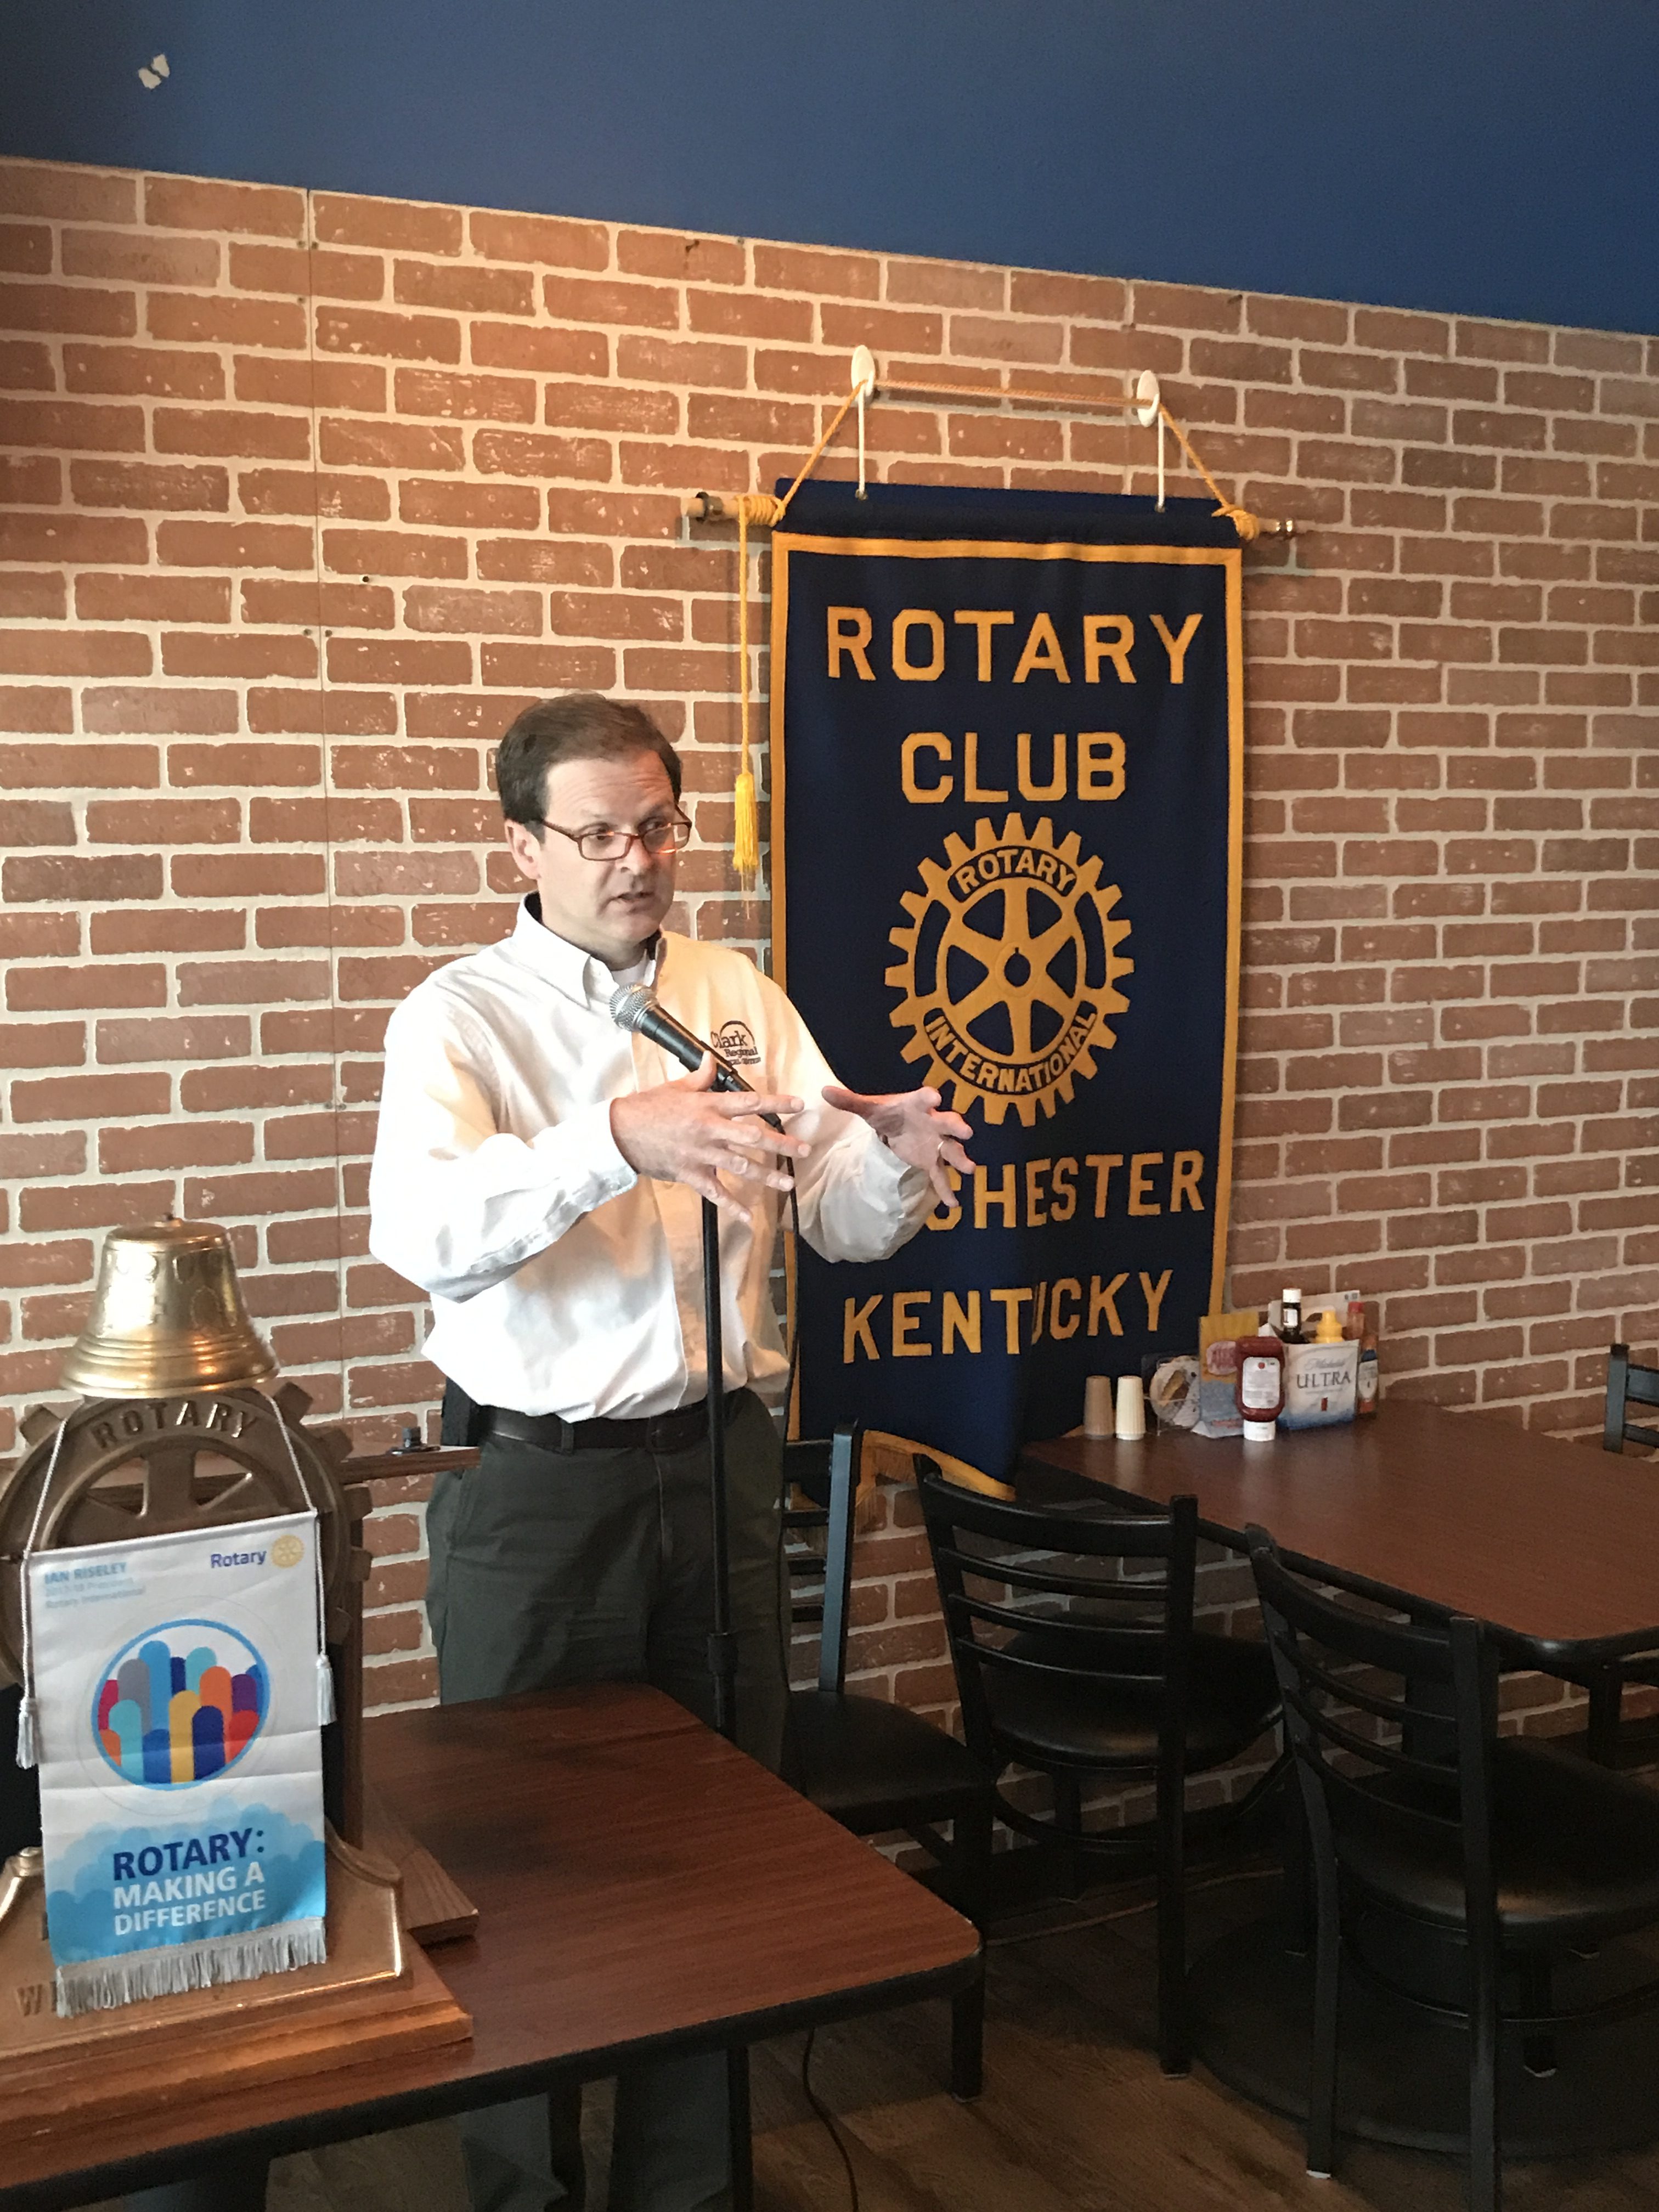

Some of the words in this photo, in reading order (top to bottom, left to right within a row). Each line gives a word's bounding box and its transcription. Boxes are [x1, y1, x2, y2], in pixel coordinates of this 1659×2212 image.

[827, 606, 1204, 684] ROTARY
[901, 731, 1126, 804] CLUB
[955, 849, 1077, 895] ROTARY
[710, 1030, 748, 1049] Clark
[924, 1011, 1097, 1092] INTERNATIONAL
[843, 1269, 1173, 1364] KENTUCKY
[1296, 1370, 1351, 1389] ULTRA
[90, 1400, 257, 1449] ROTARY
[211, 1549, 267, 1568] Rotary
[114, 1827, 264, 1881] ROTARY:
[114, 1866, 237, 1909] MAKING
[245, 1861, 264, 1885] A
[115, 1889, 266, 1936] DIFFERENCE
